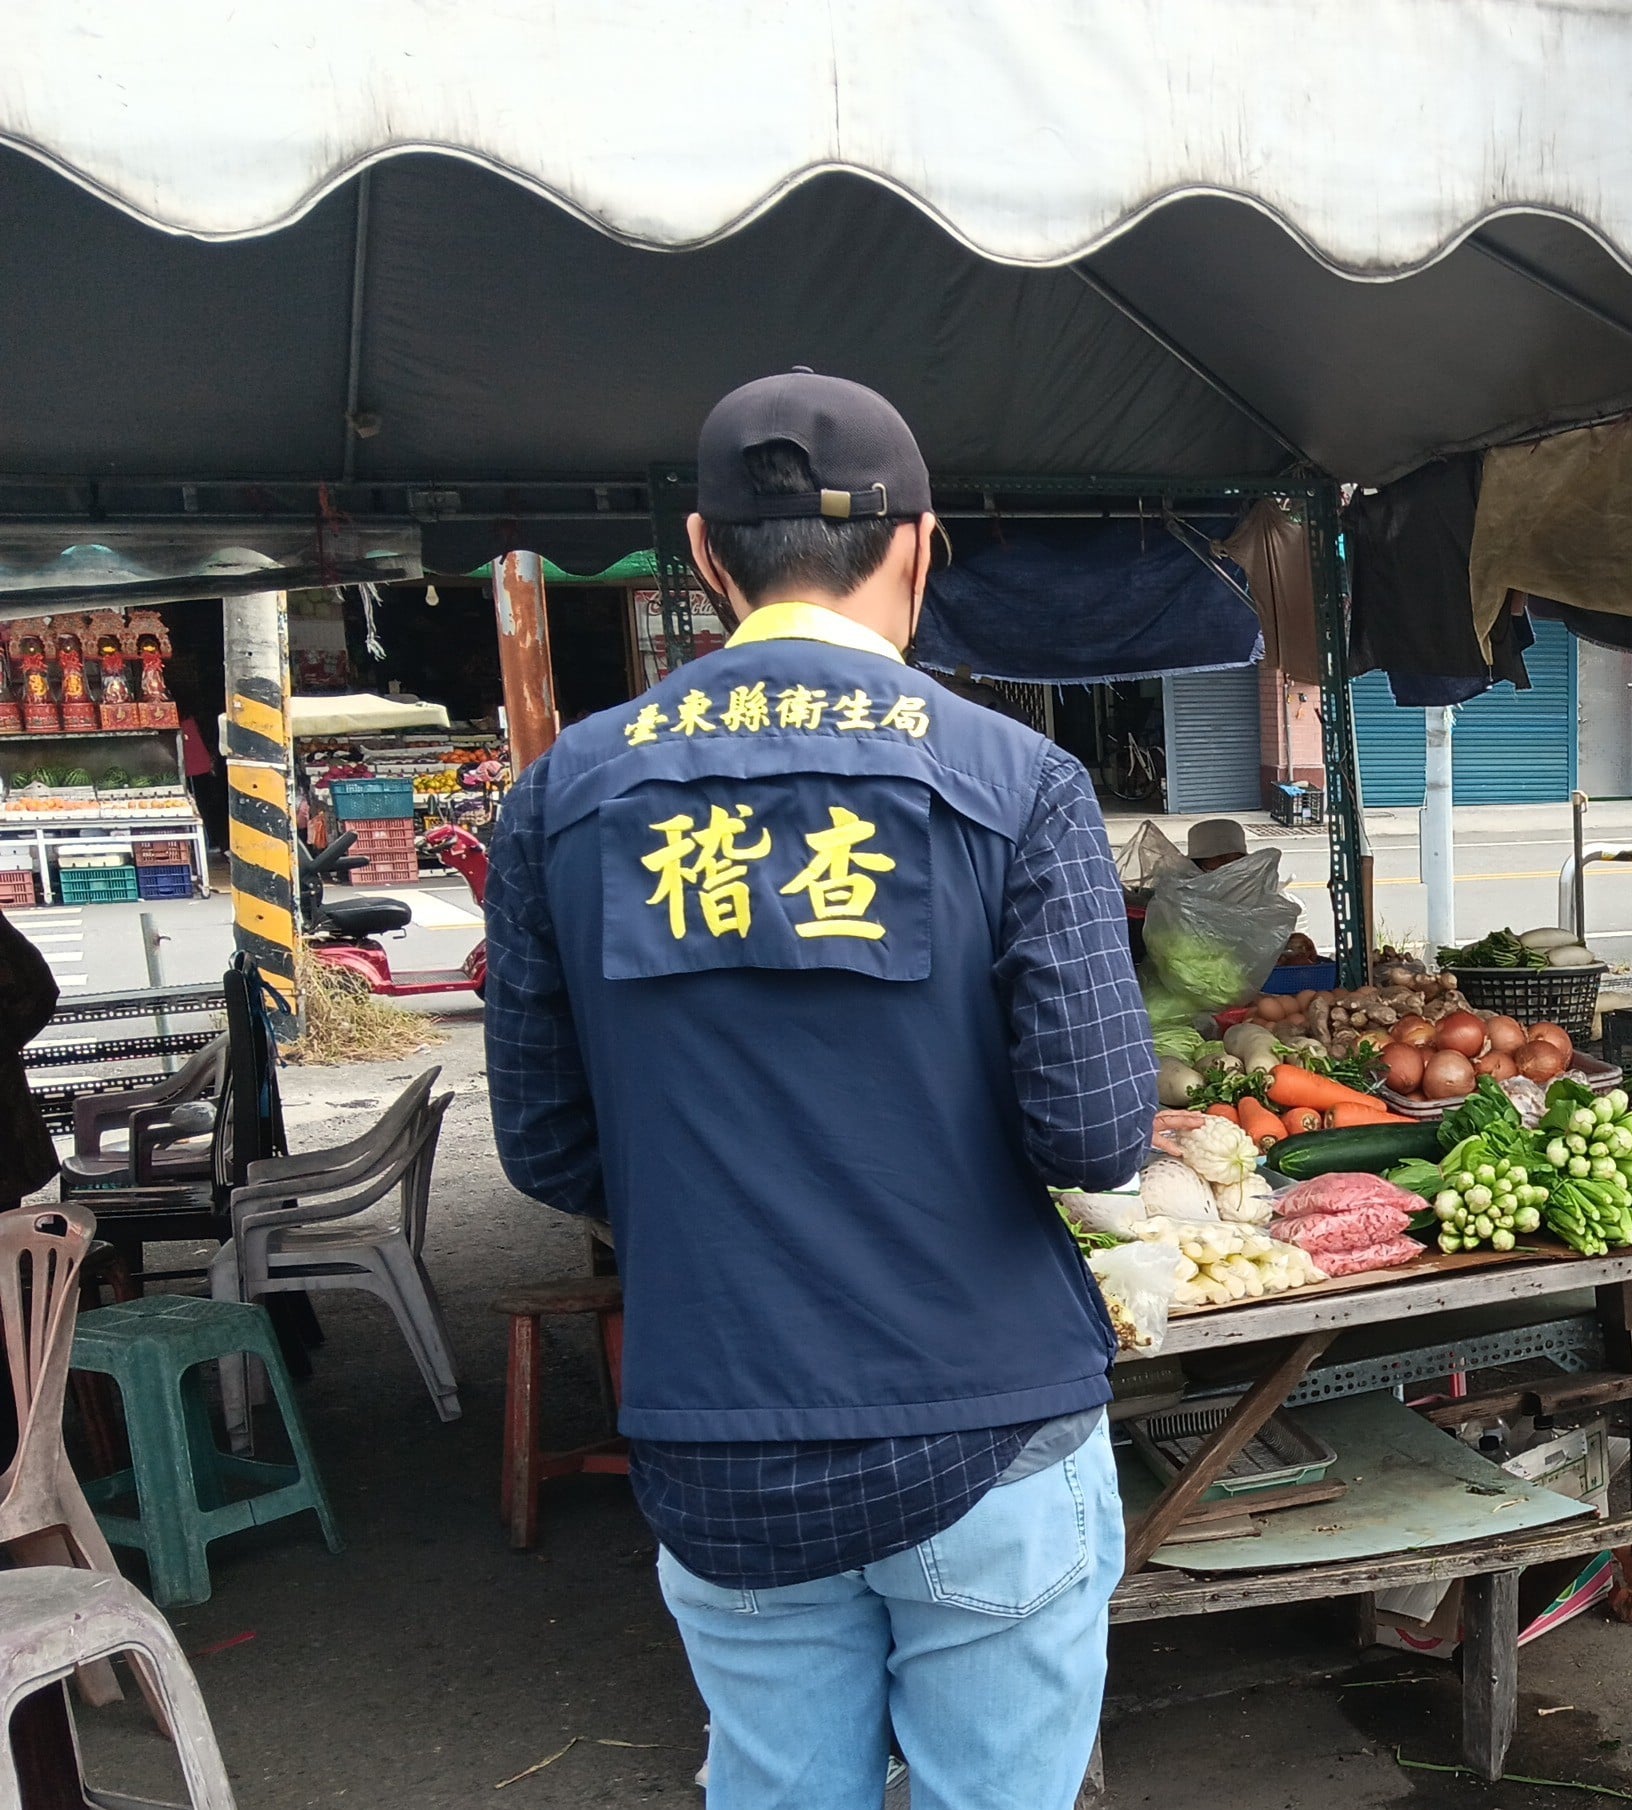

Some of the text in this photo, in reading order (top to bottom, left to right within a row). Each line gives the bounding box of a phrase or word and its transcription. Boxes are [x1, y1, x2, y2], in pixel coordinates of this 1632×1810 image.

[624, 681, 931, 747] 臺東縣衛生局
[641, 804, 897, 940] 稽查
